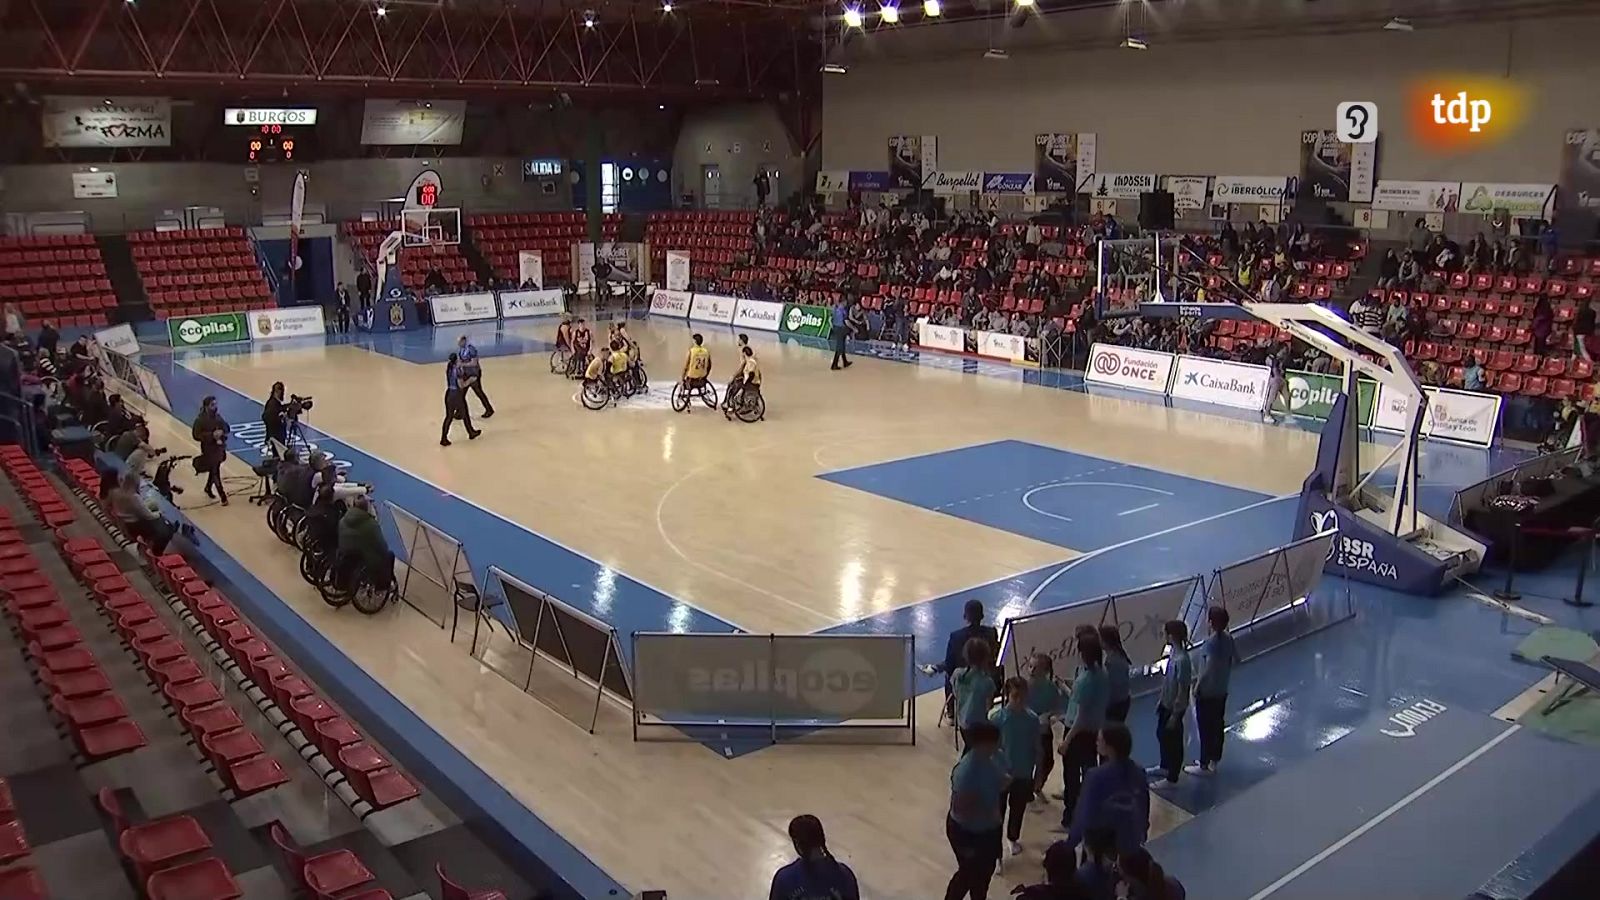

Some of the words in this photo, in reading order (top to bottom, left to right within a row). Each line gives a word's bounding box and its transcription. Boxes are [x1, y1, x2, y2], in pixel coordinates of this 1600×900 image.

[248, 111, 306, 122] BURGOS
[250, 141, 262, 150] 00
[282, 141, 294, 150] 00
[525, 162, 553, 175] SALIDA
[936, 172, 980, 190] Burpellet
[421, 193, 435, 205] 00
[666, 301, 685, 310] ONCE
[748, 308, 776, 321] CaixaBank
[788, 313, 823, 327] ecopilas
[180, 321, 235, 337] ecopilas
[1123, 357, 1158, 369] Fundación
[1121, 363, 1156, 381] ONCE
[1200, 374, 1256, 395] CaixaBank
[1339, 536, 1374, 560] BSR
[1337, 553, 1398, 580] ESPAÑA
